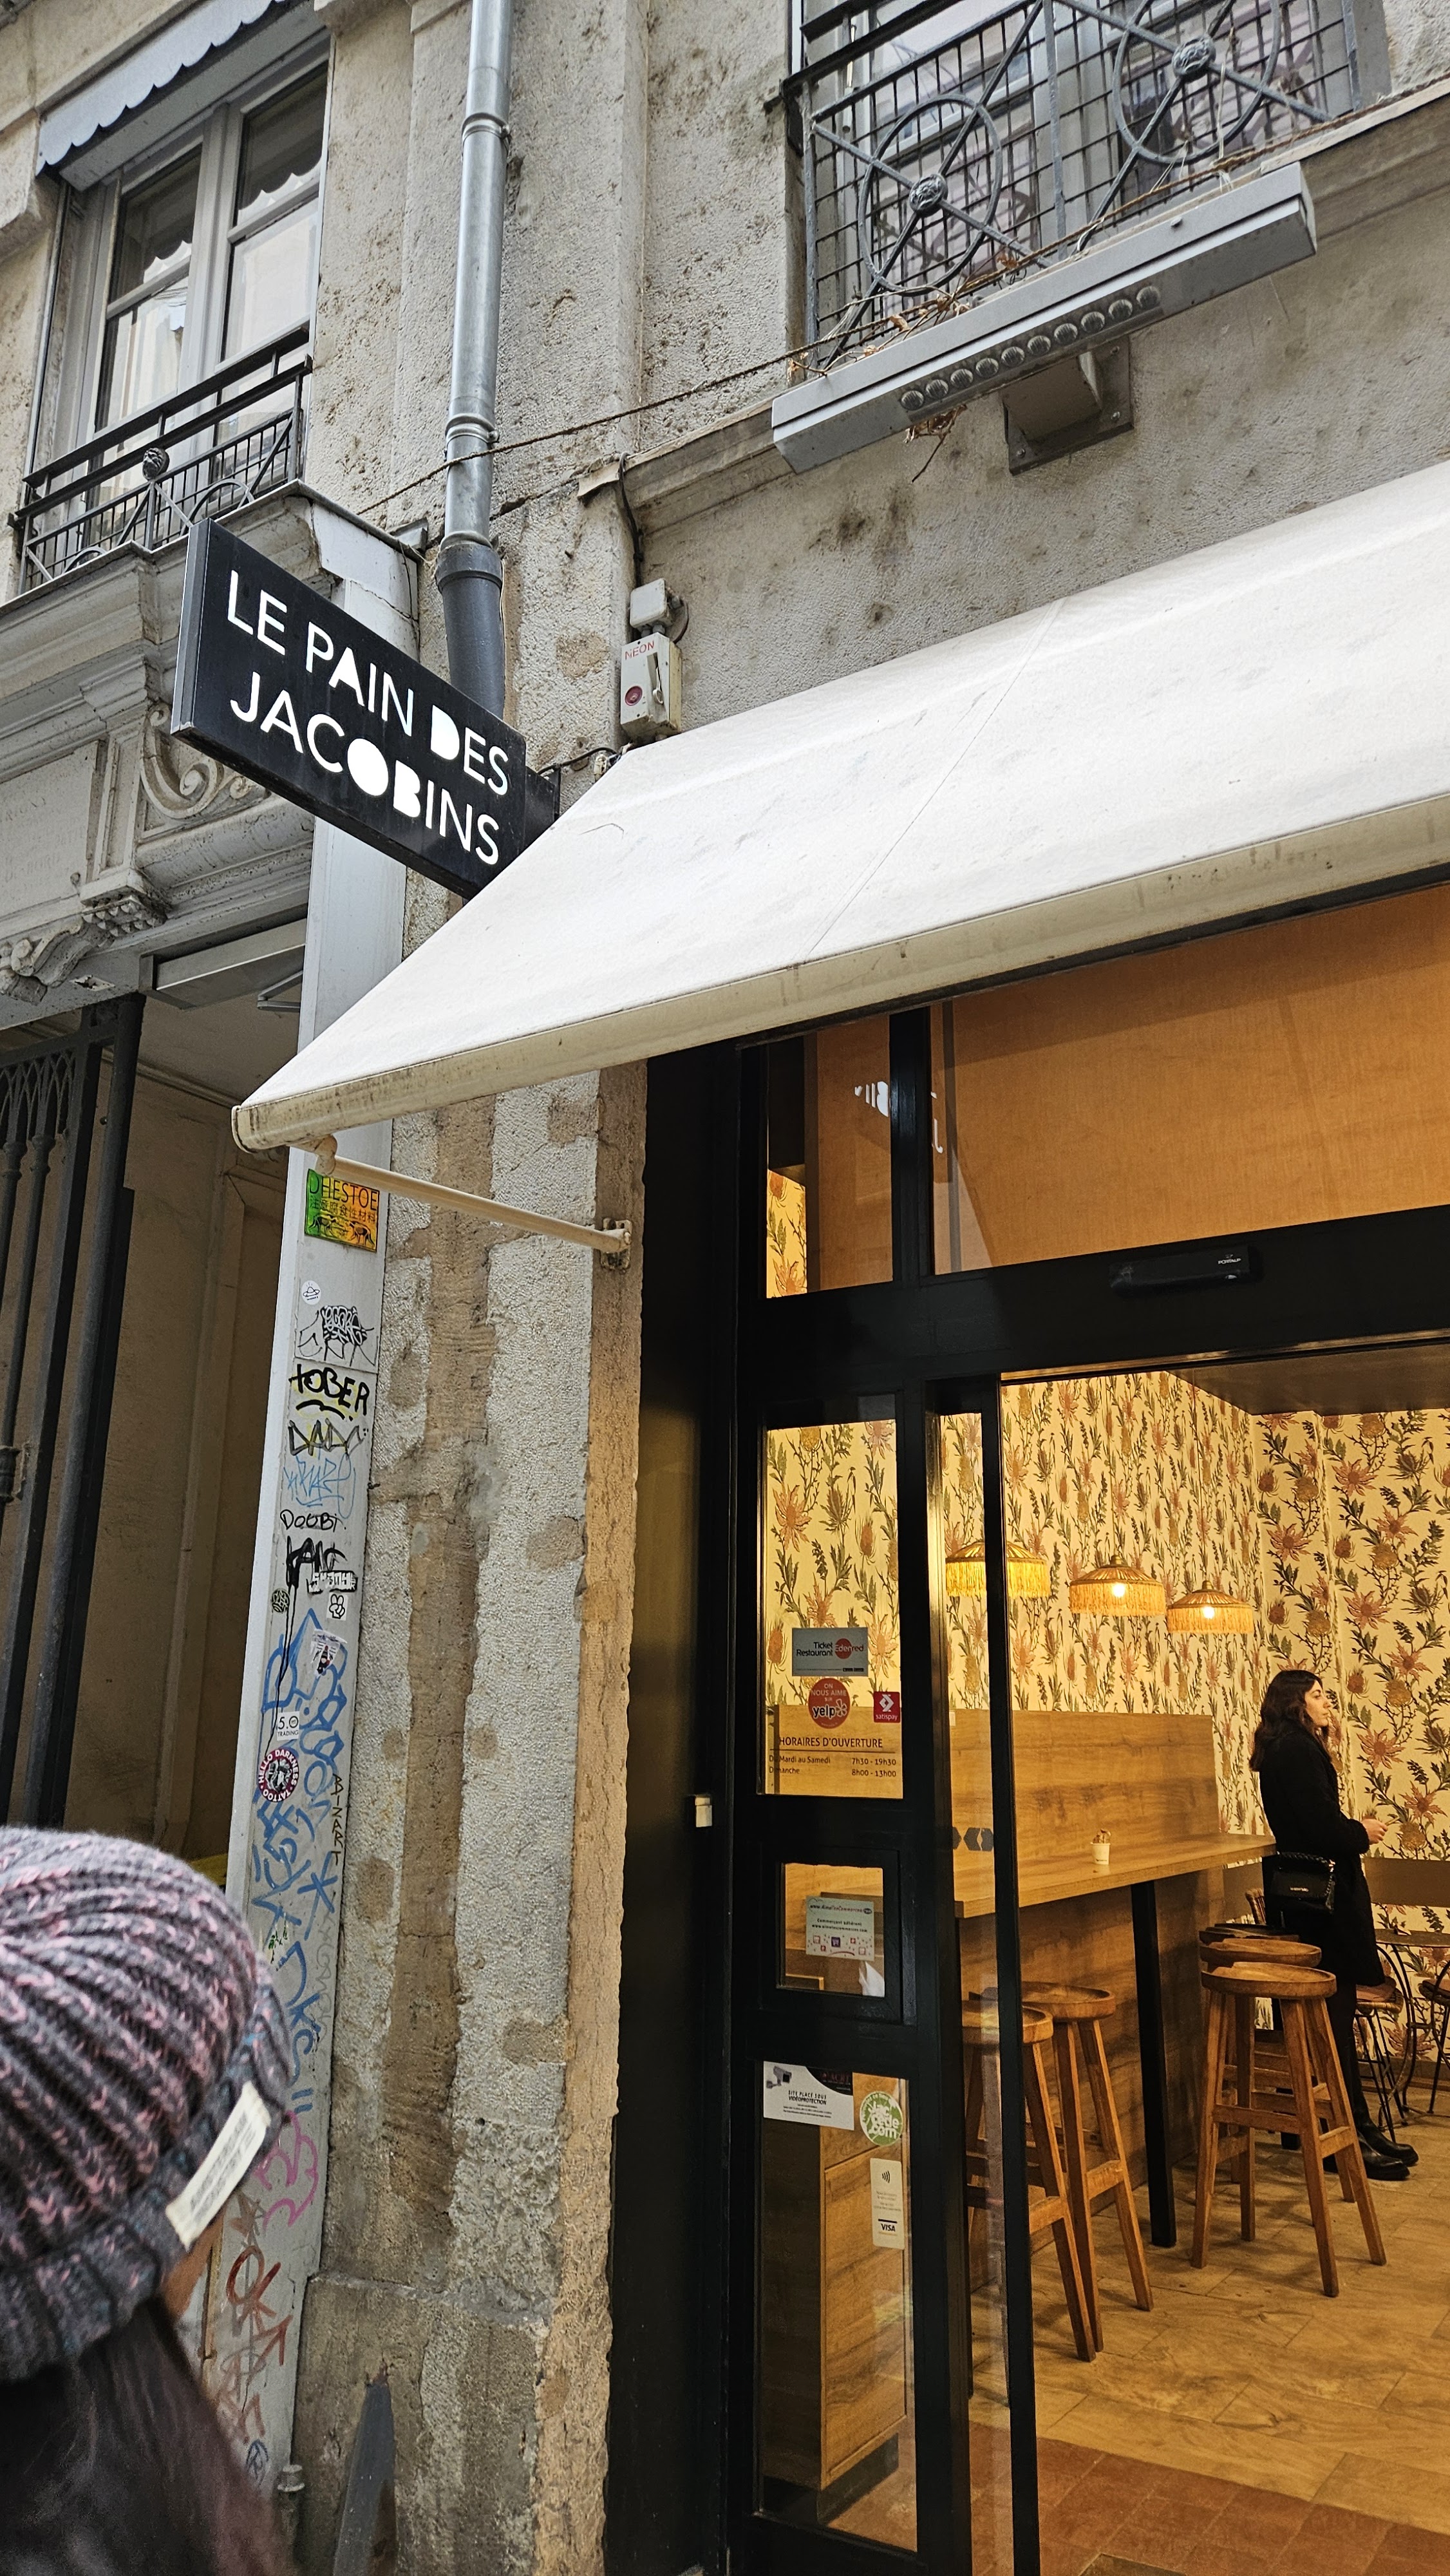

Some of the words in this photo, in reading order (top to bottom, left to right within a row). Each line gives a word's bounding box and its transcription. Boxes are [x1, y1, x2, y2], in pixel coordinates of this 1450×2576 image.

[625, 640, 655, 660] NEON
[228, 570, 287, 654] LE
[306, 621, 414, 736] PAIN
[431, 705, 509, 795] DES
[230, 671, 499, 865] JACOBINS
[309, 1174, 377, 1211] DHESTOE
[835, 1644, 864, 1653] Edenred
[813, 1704, 836, 1719] yelp
[779, 1736, 820, 1747] HORAIRES
[823, 1737, 883, 1748] D'OUVERTURE
[779, 1755, 796, 1763] Mardi
[807, 1756, 831, 1764] Samedi
[259, 1754, 274, 1784] HELLO
[275, 1749, 299, 1786] DARKNESS
[875, 1769, 896, 1777] 13h00
[263, 1789, 291, 1802] TATTOO
[880, 2223, 896, 2232] VISA
